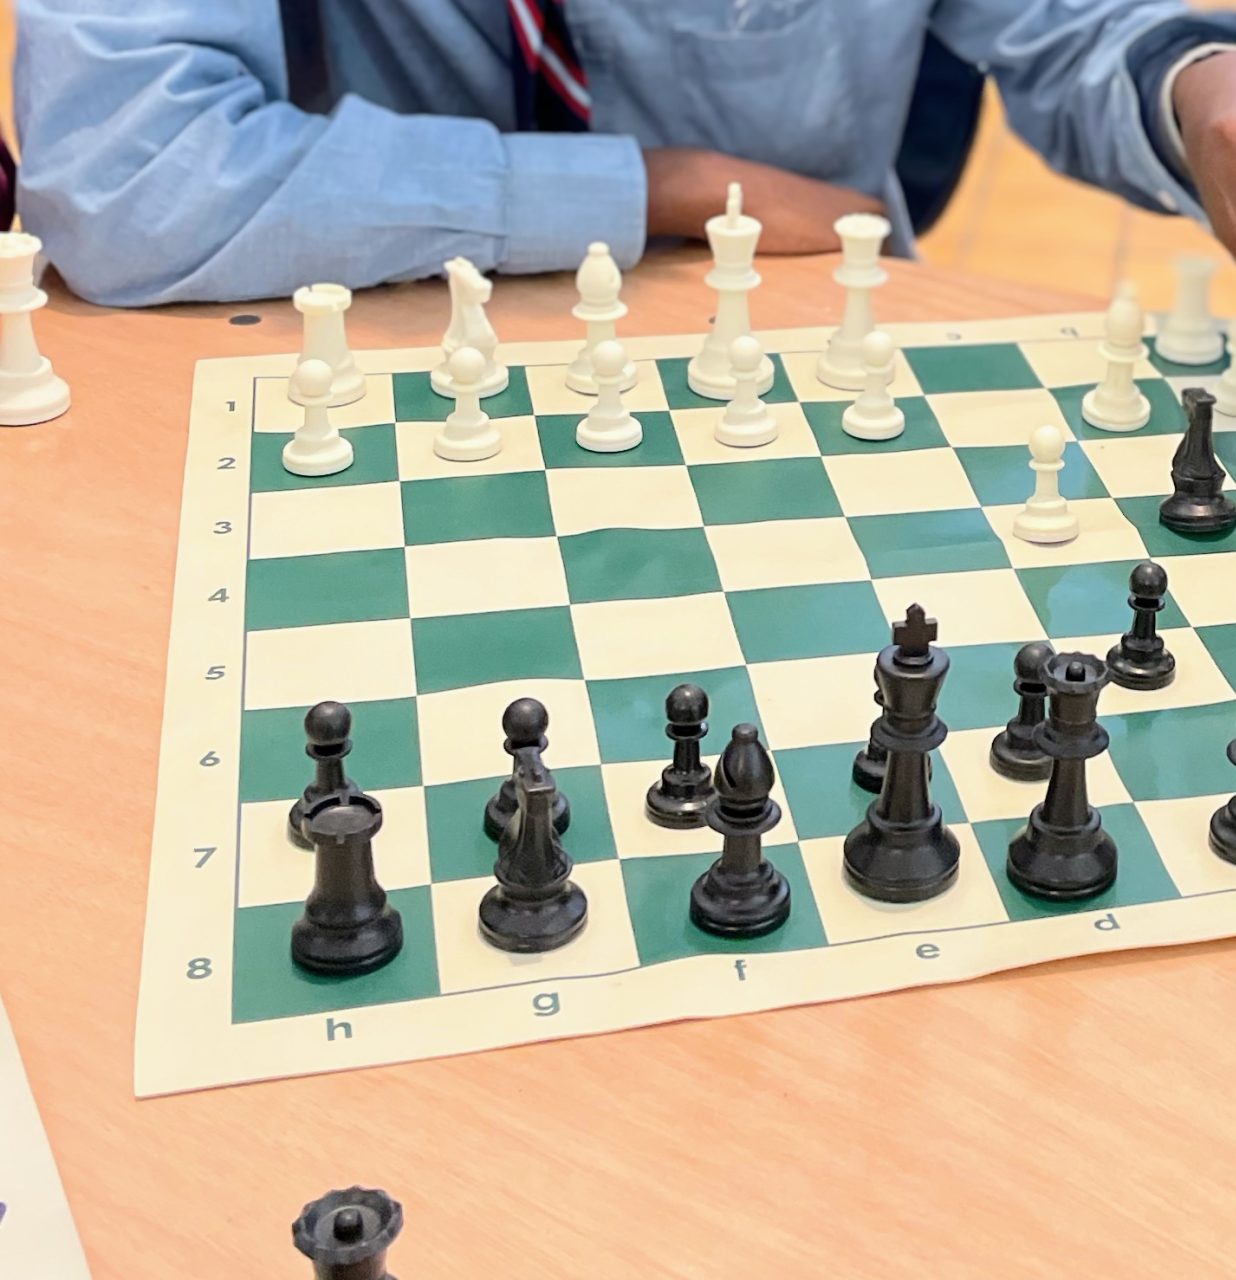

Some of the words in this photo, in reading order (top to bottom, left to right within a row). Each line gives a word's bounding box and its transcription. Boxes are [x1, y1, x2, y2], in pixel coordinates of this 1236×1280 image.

[225, 400, 236, 412] 1
[216, 457, 236, 470] 2
[212, 521, 233, 535] 3
[207, 587, 230, 603] 4
[204, 665, 226, 681] 5
[199, 750, 221, 768] 6
[193, 846, 218, 869] 7
[1094, 913, 1120, 931] d
[915, 943, 940, 960] e
[186, 957, 213, 980] 8
[734, 959, 747, 981] f
[532, 992, 561, 1017] g
[326, 1017, 353, 1042] h
